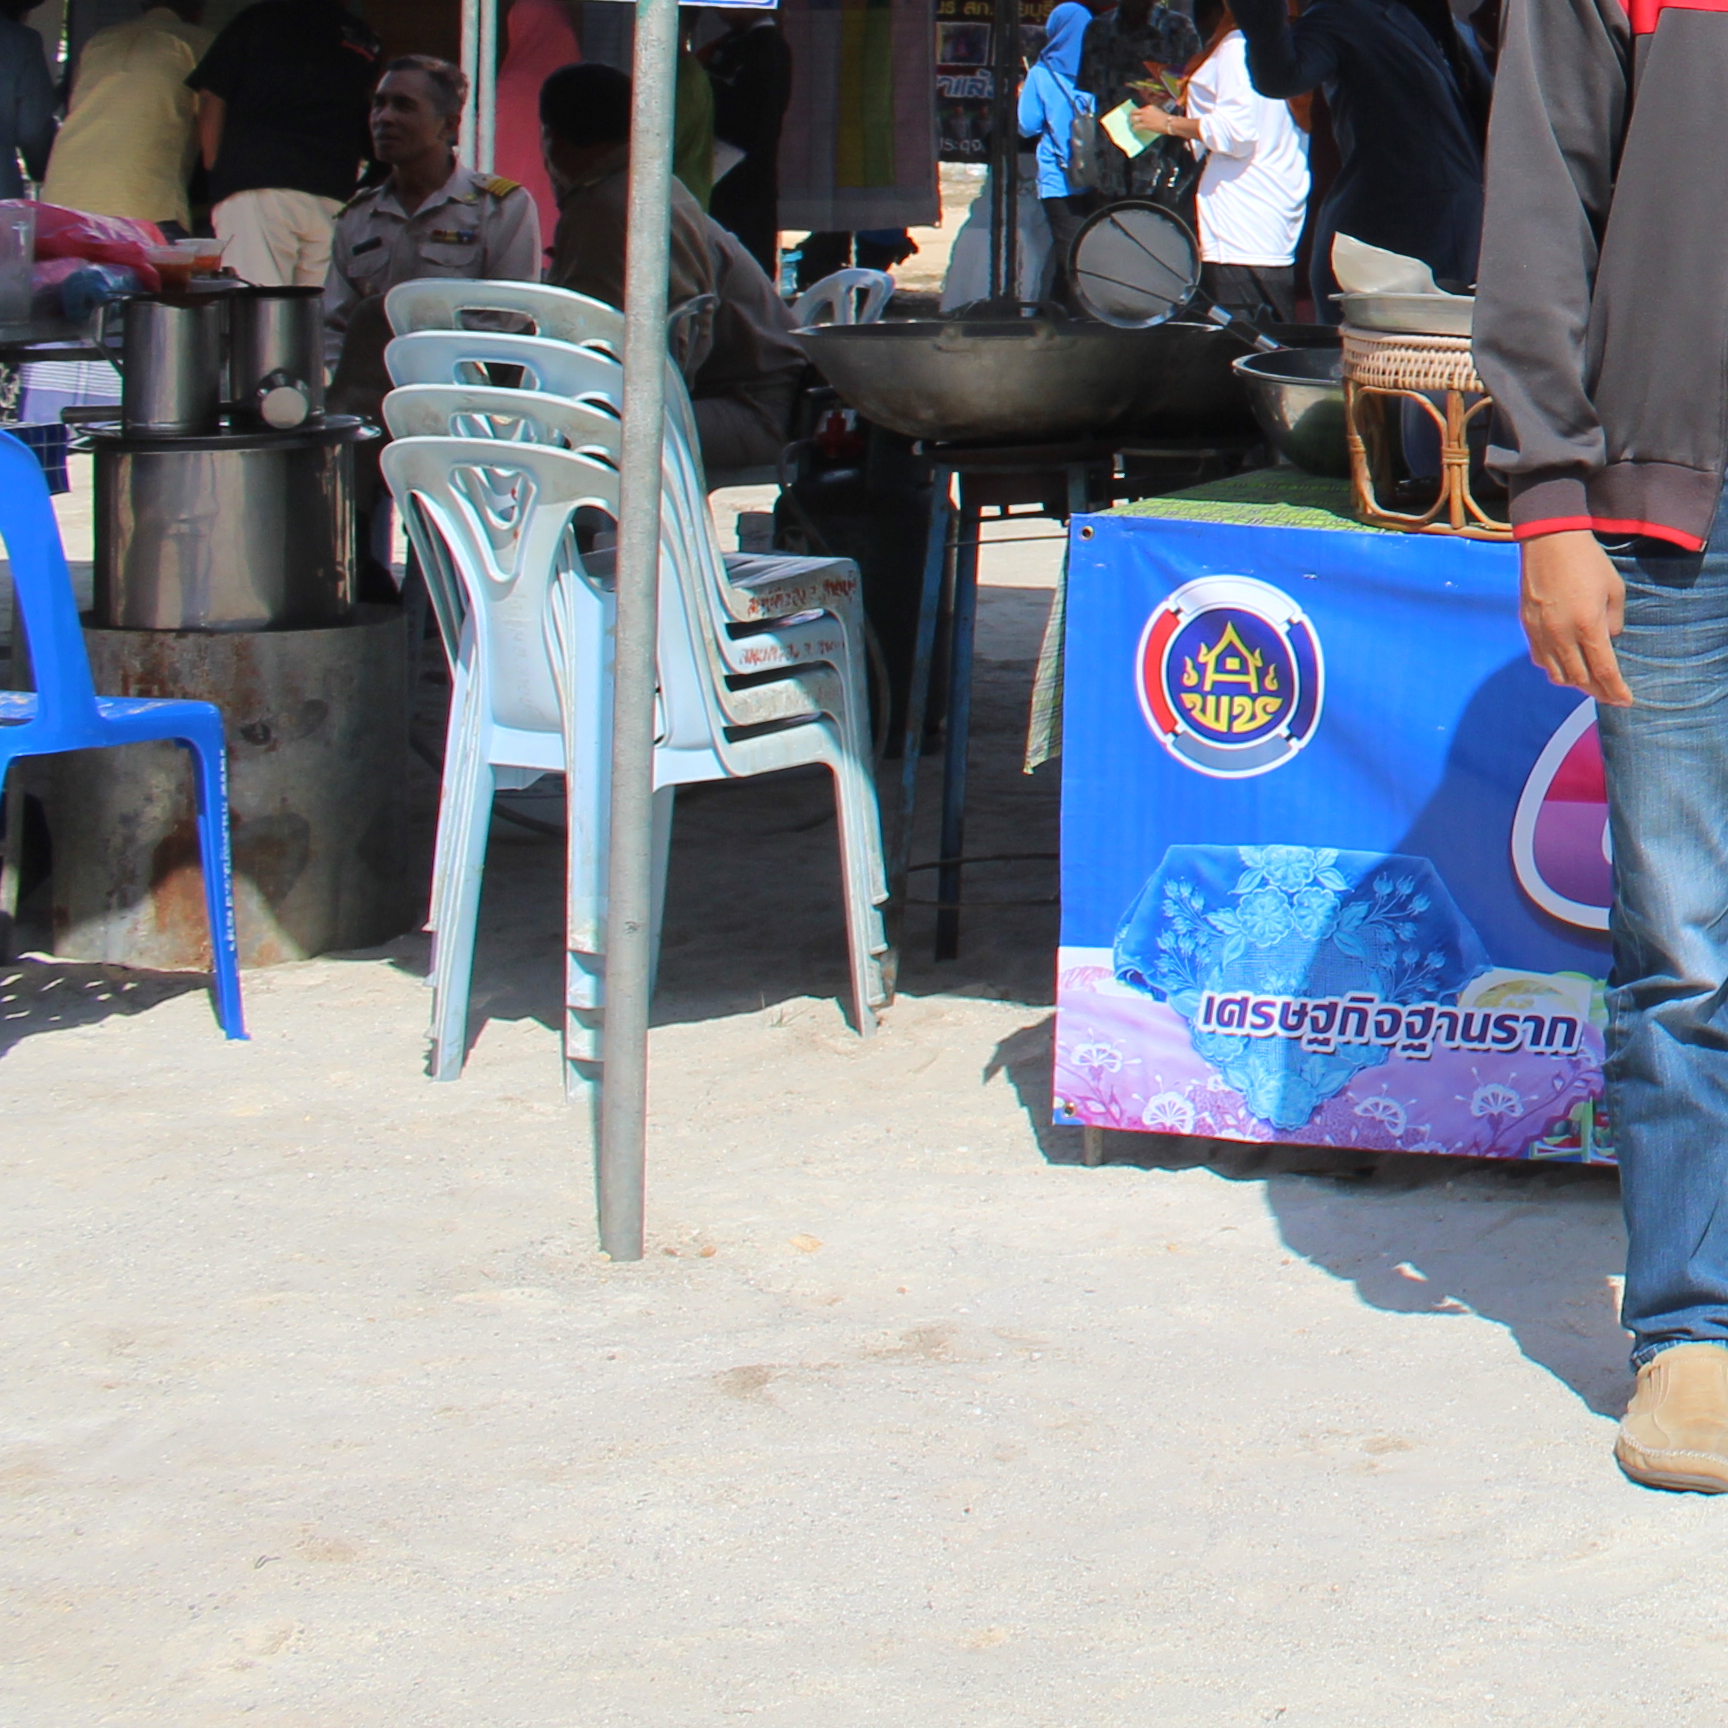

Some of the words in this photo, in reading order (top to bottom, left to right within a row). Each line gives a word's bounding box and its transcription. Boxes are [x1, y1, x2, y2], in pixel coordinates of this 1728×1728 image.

[1201, 994, 1580, 1058] เศรษฐกิจฐานราก
